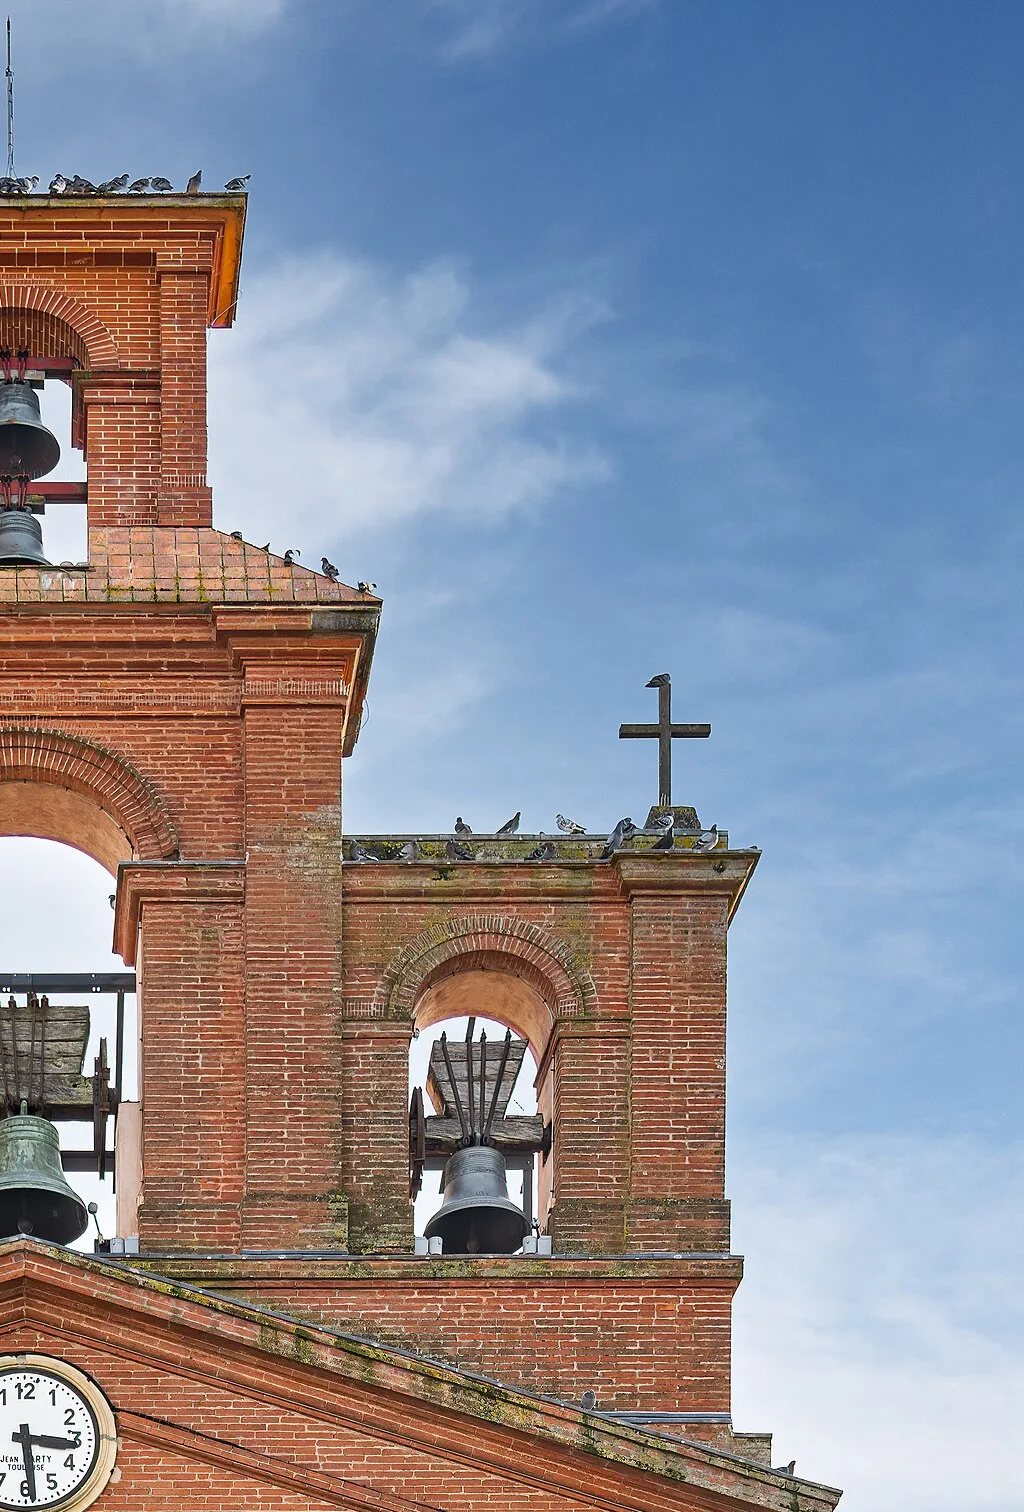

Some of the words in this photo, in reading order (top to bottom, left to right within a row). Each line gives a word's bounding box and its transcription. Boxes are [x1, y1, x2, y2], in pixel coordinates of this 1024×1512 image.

[14, 1382, 36, 1400] 12
[48, 1388, 56, 1406] 1
[63, 1408, 76, 1426] 2
[0, 1454, 19, 1463] JEAN
[63, 1453, 76, 1471] 4
[19, 1480, 31, 1498] 6
[46, 1472, 58, 1490] 5
